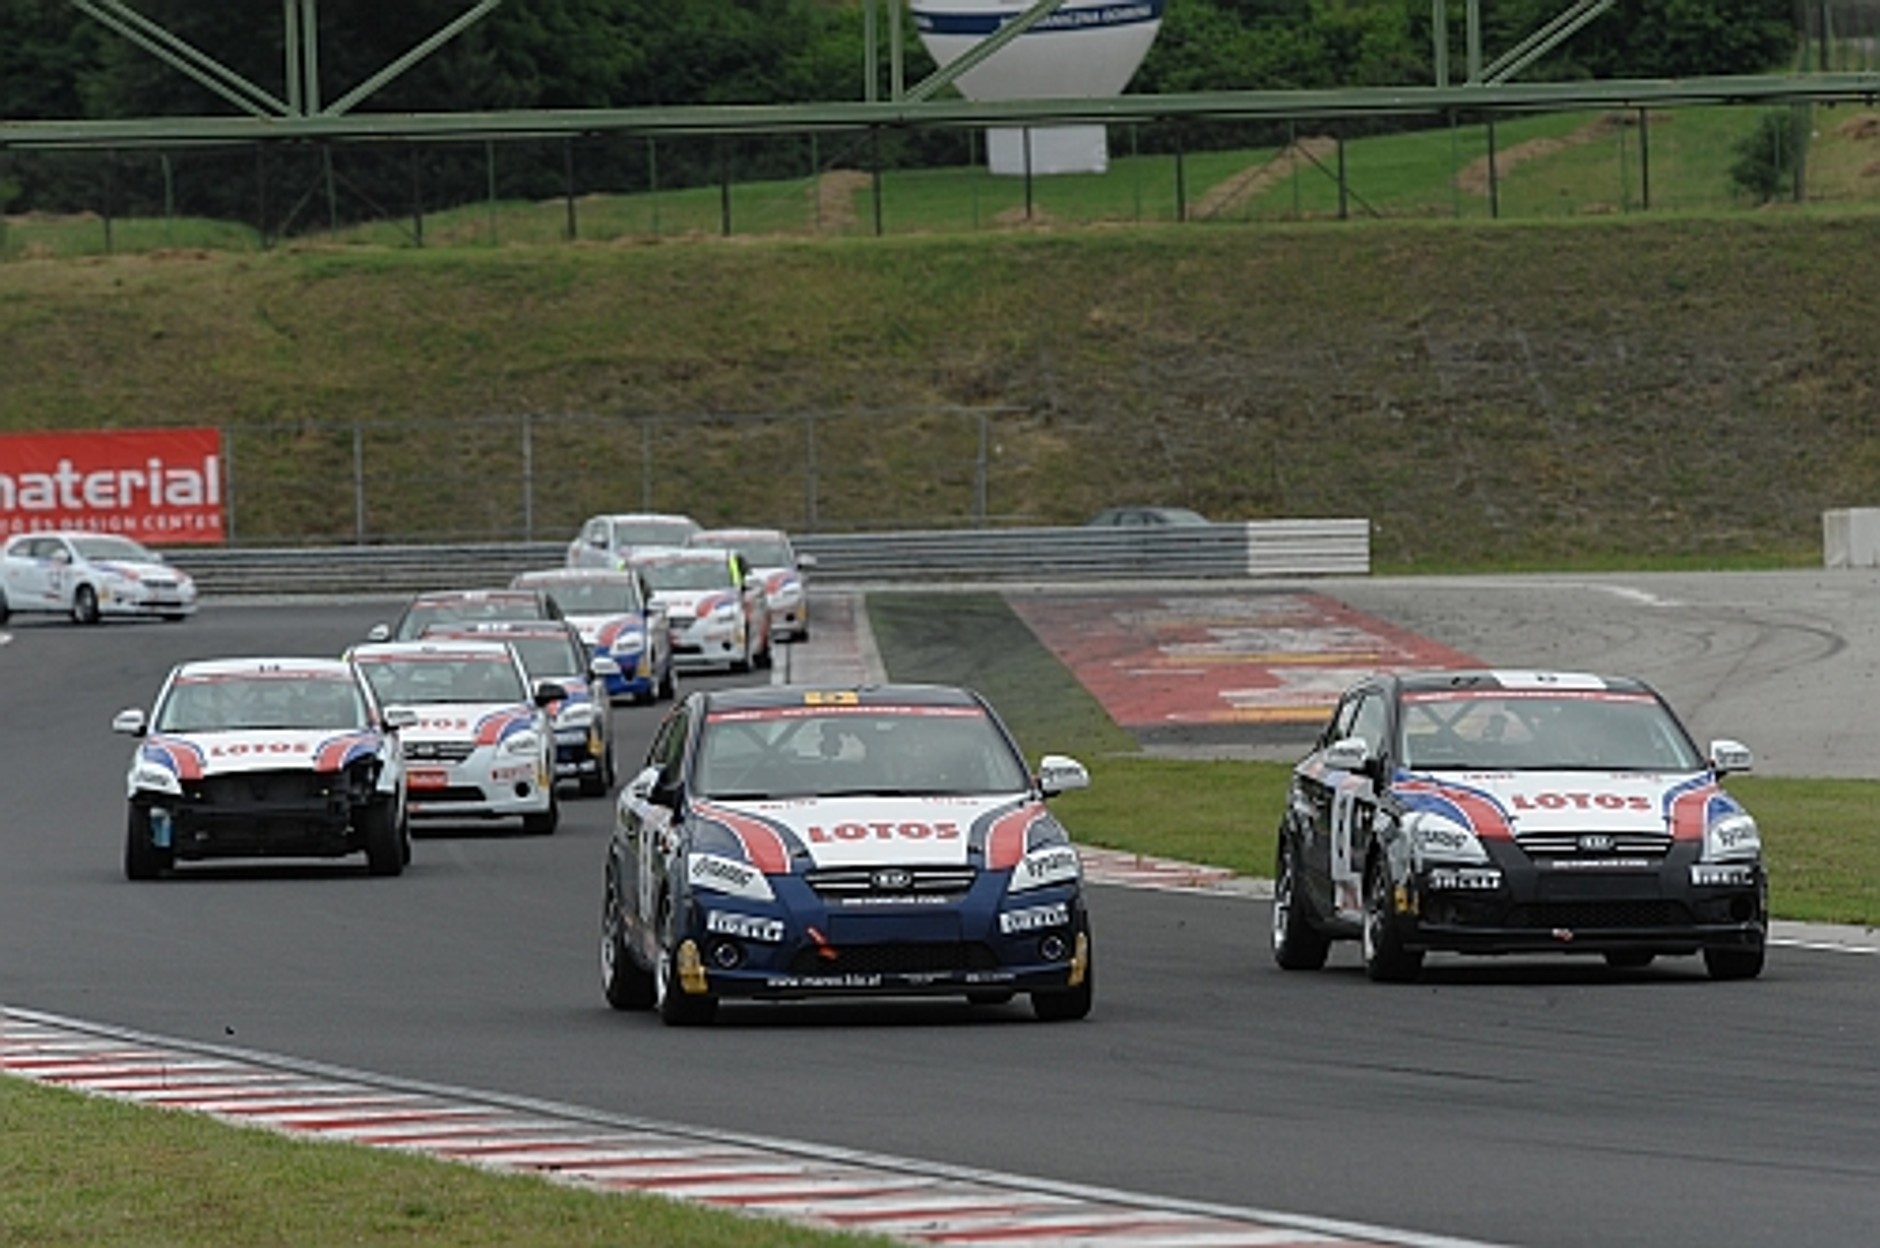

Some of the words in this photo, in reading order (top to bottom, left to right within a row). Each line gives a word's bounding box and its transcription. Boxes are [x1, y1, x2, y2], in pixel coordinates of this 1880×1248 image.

[60, 515, 137, 532] DESIGN
[142, 514, 220, 530] CENTER
[210, 742, 309, 757] LOTOS
[1512, 793, 1652, 811] LOTOS
[808, 822, 960, 844] LOTOS
